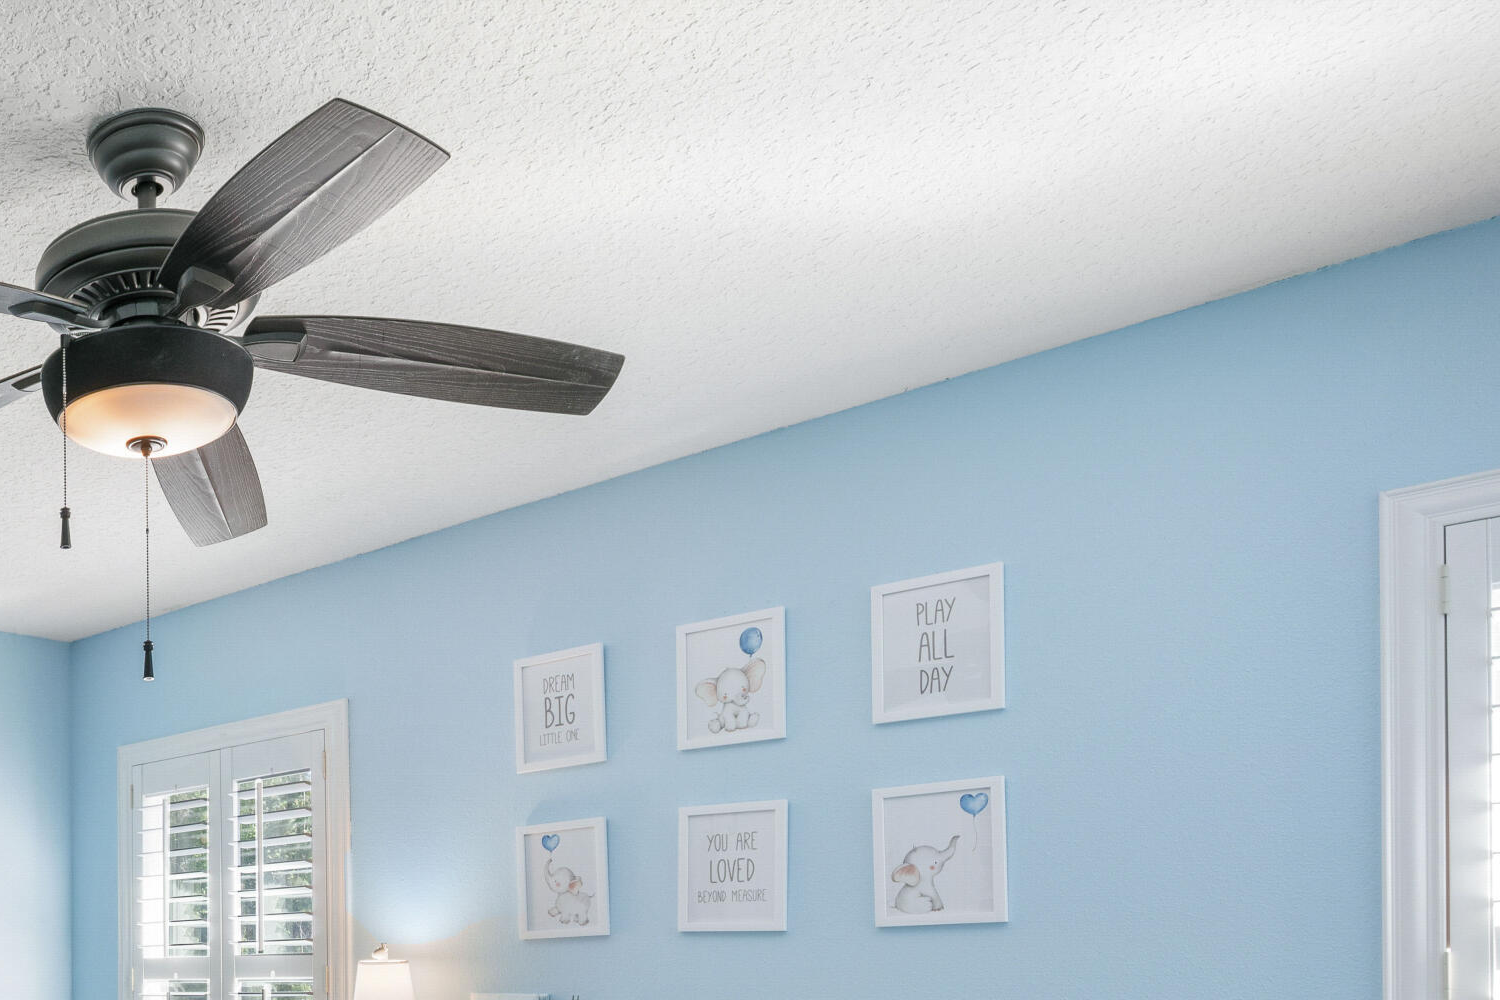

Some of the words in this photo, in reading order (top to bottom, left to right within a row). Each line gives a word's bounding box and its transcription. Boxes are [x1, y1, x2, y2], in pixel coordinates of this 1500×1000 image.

[916, 596, 956, 626] PLAY
[918, 628, 955, 662] ALL
[542, 673, 576, 695] DREAM
[920, 665, 954, 695] DAY
[544, 693, 576, 729] BIG
[539, 731, 564, 747] LITTLE
[565, 728, 580, 743] ONE
[706, 833, 728, 852] YOU
[735, 831, 759, 851] ARE
[709, 857, 755, 884] LOVED
[697, 889, 727, 904] BEYOND
[731, 888, 769, 903] MEASURE
